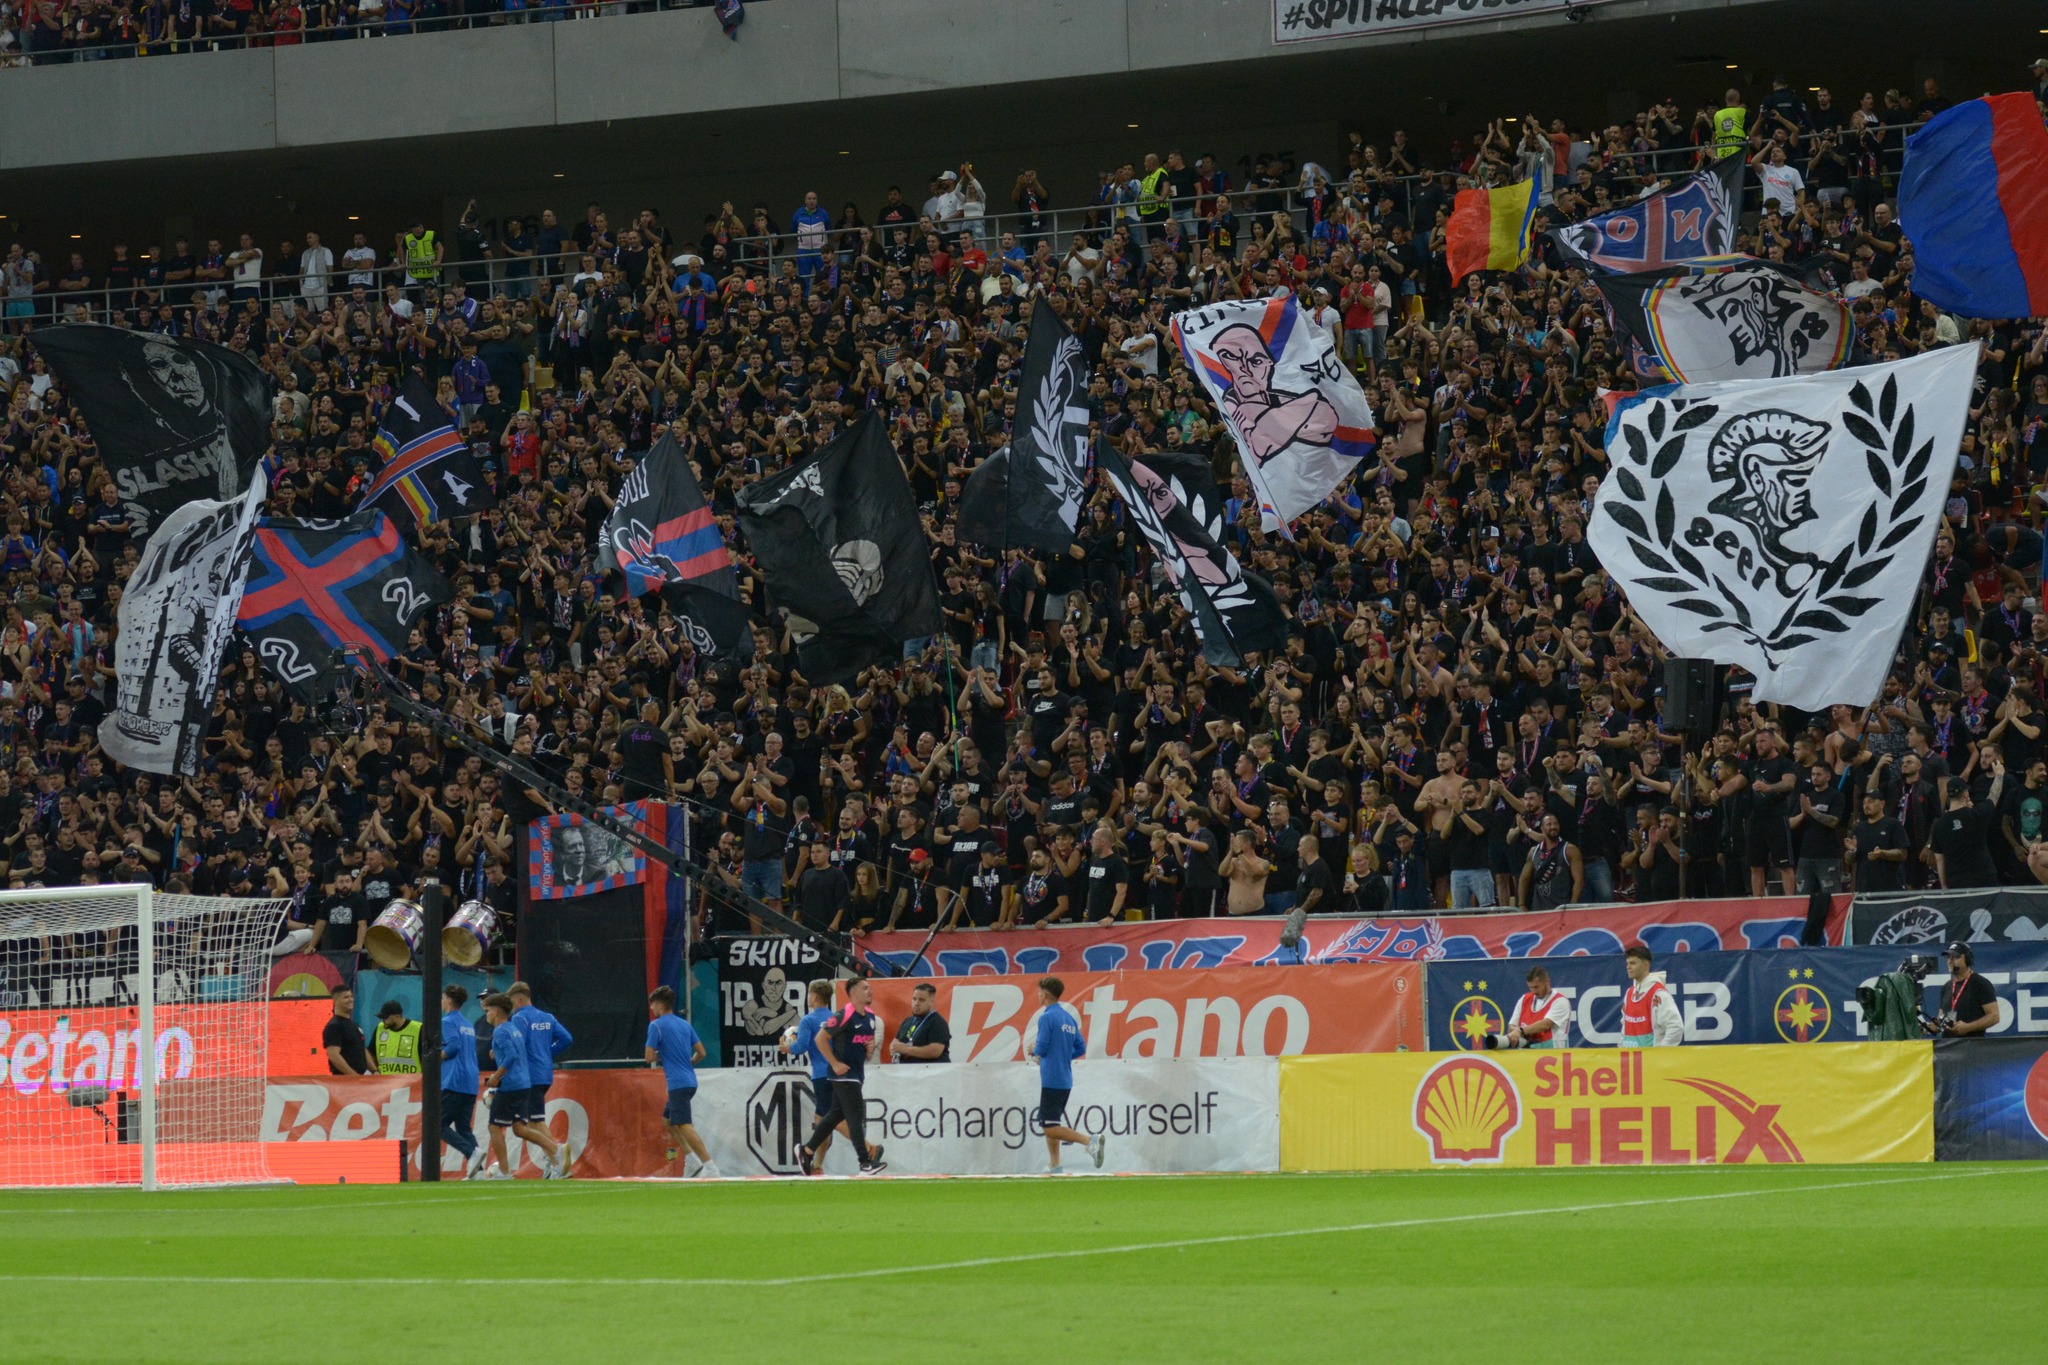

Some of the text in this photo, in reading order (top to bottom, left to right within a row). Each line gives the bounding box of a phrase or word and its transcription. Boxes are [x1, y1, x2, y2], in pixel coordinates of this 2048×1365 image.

[1684, 516, 1771, 592] Beer
[1051, 801, 1075, 811] adidas
[729, 938, 820, 966] SKINS
[0, 1013, 194, 1095] etano
[1534, 1051, 1643, 1098] Shell
[259, 1084, 590, 1174] Beto
[865, 1091, 1219, 1150] Recharge yourself
[1531, 1100, 1805, 1165] HELIX
